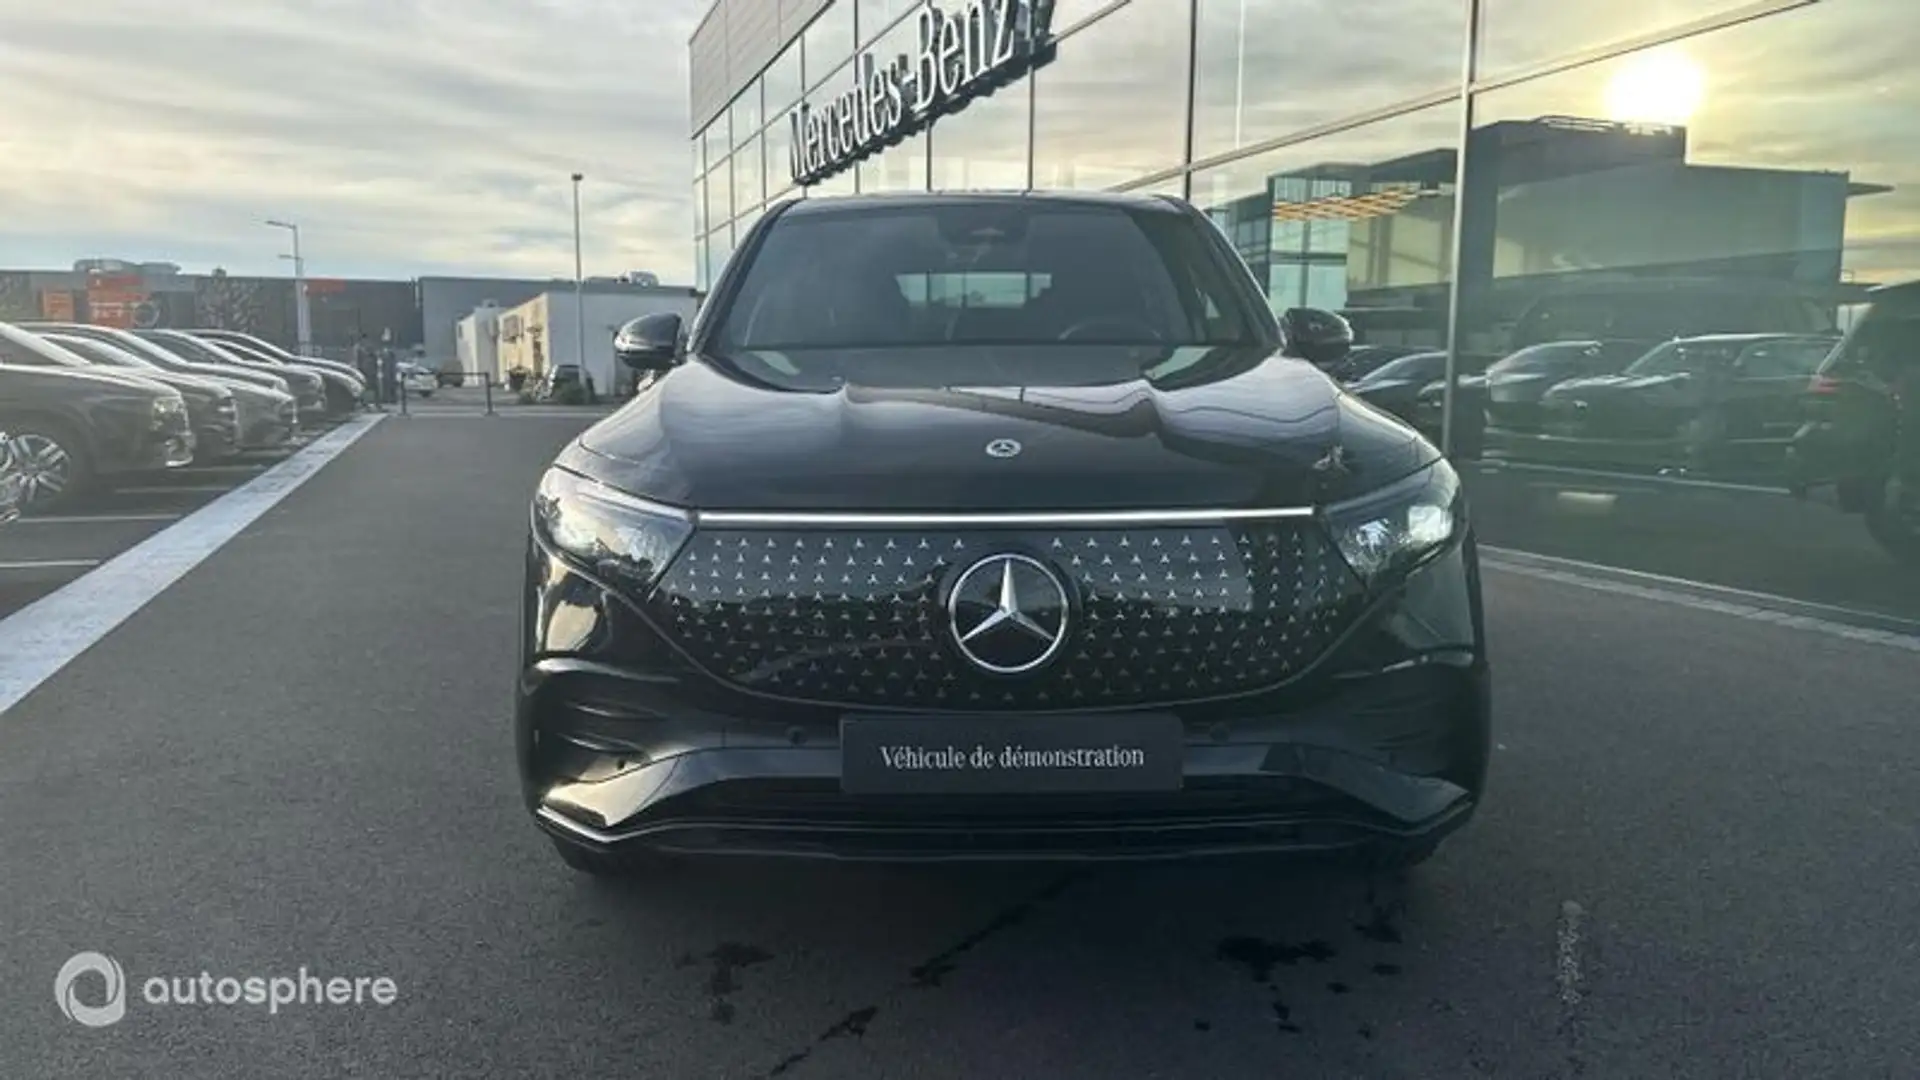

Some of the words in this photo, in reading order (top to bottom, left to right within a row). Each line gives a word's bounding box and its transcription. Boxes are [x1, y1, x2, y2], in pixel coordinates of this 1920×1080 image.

[787, 0, 1015, 178] Mercedes-Benz
[880, 745, 966, 769] Véhicule
[969, 745, 994, 769] de
[999, 744, 1145, 768] démonstration
